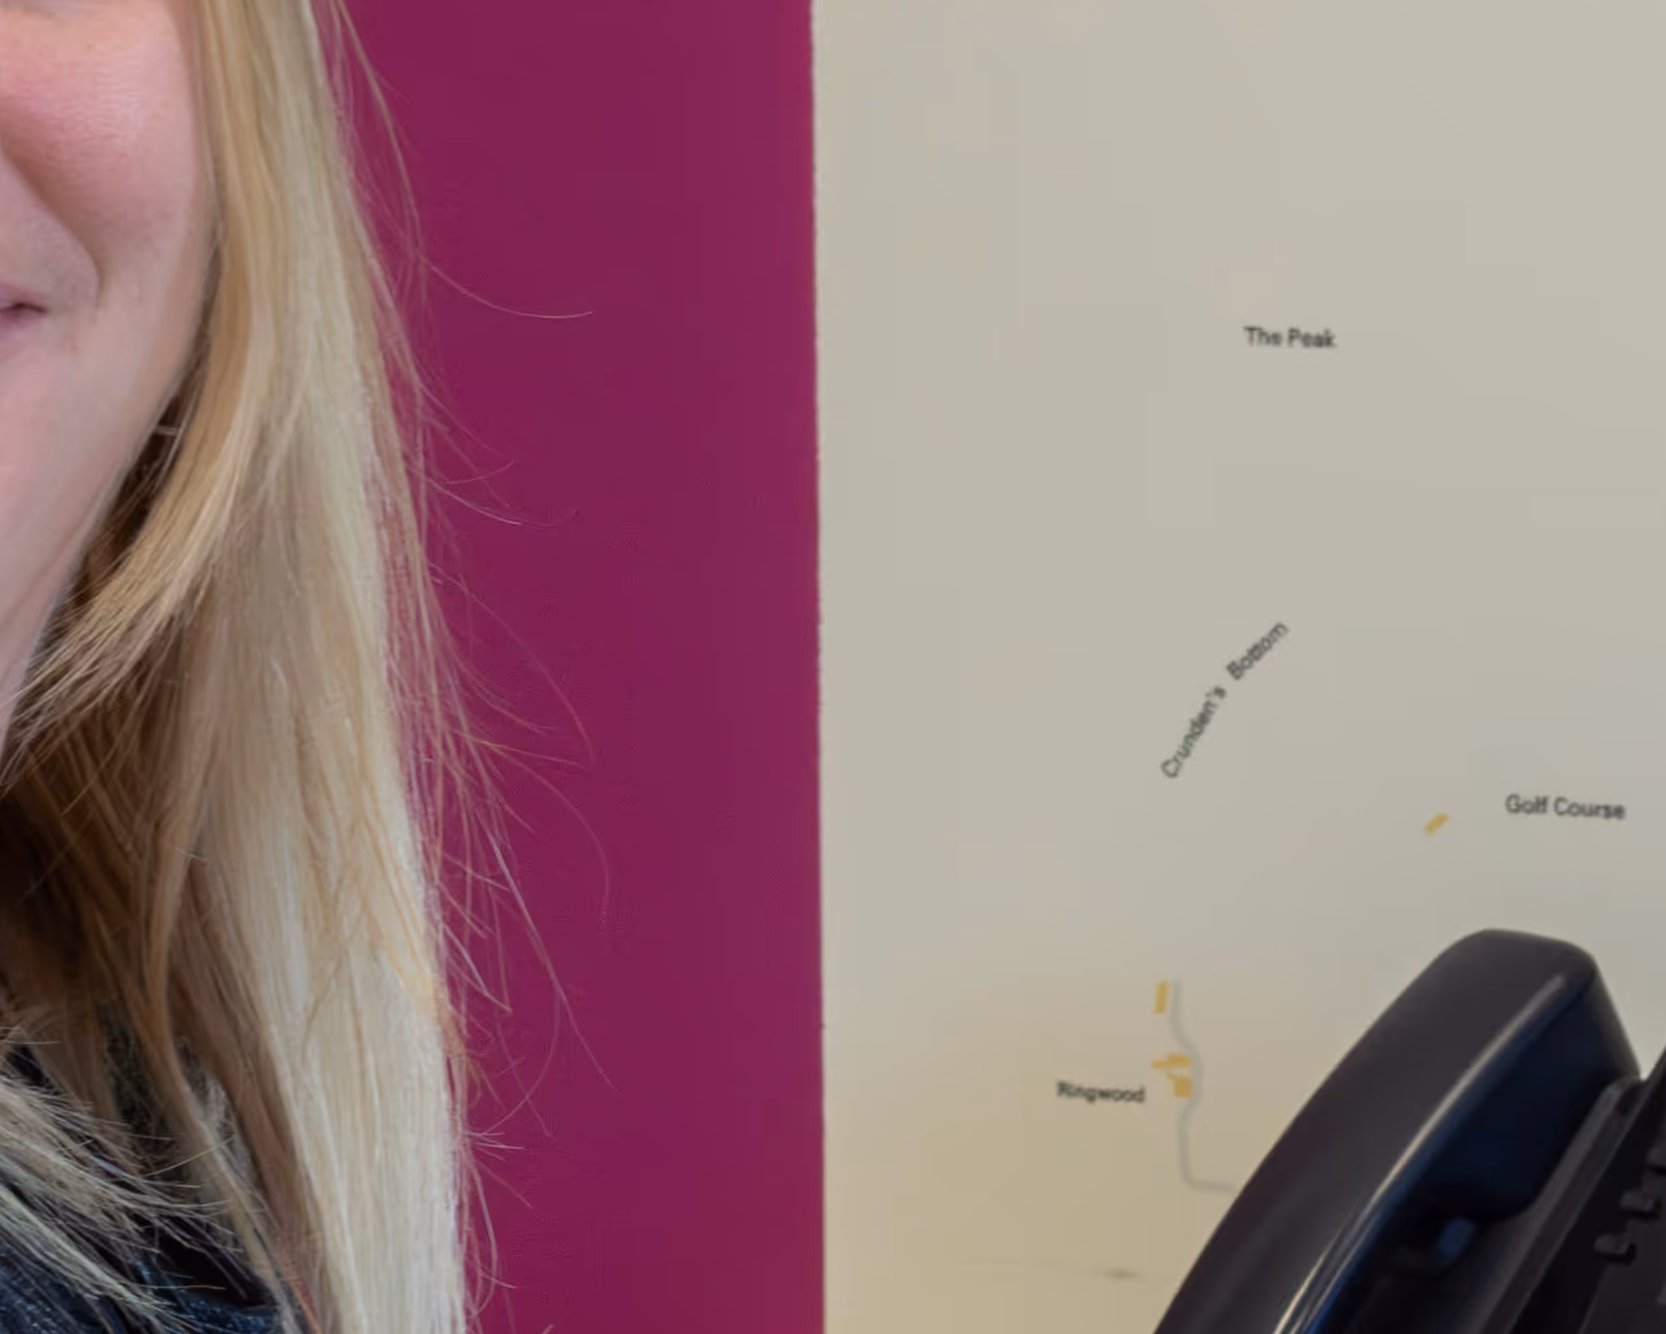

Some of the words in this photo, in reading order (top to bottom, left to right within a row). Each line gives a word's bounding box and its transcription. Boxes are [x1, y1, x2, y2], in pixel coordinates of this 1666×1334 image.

[1244, 327, 1284, 349] The
[1287, 328, 1336, 351] Peak
[1161, 683, 1228, 781] Crunden's
[1226, 622, 1289, 681] Bottom
[1506, 795, 1549, 820] Golf
[1553, 796, 1627, 822] Course
[1056, 1081, 1146, 1105] Ringwood
